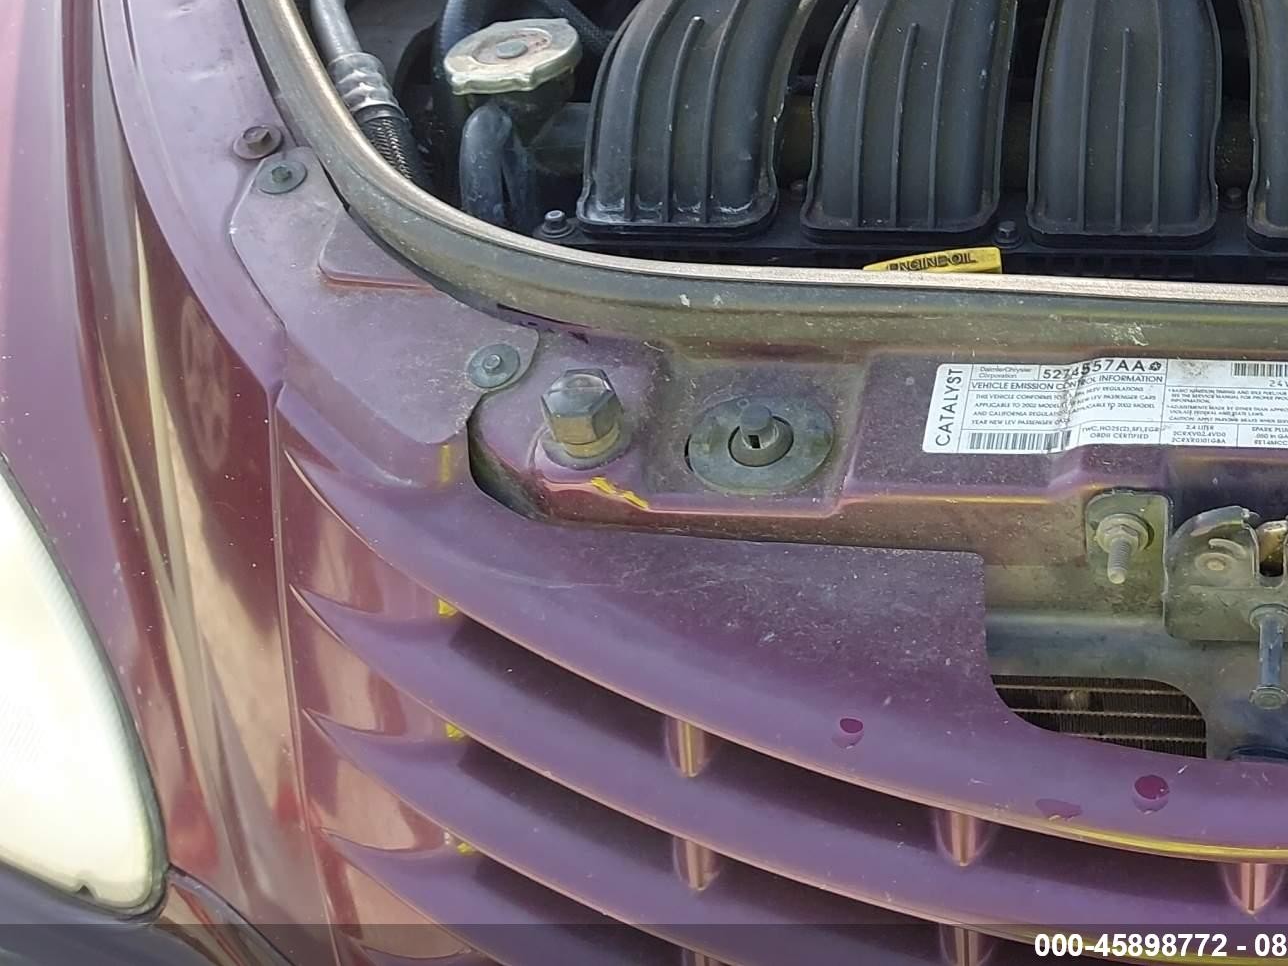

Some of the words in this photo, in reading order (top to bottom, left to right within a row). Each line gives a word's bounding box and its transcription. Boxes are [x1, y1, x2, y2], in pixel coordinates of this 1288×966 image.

[950, 252, 977, 264] OIL
[1010, 382, 1054, 390] EMISSION
[935, 368, 963, 446] CATALYST
